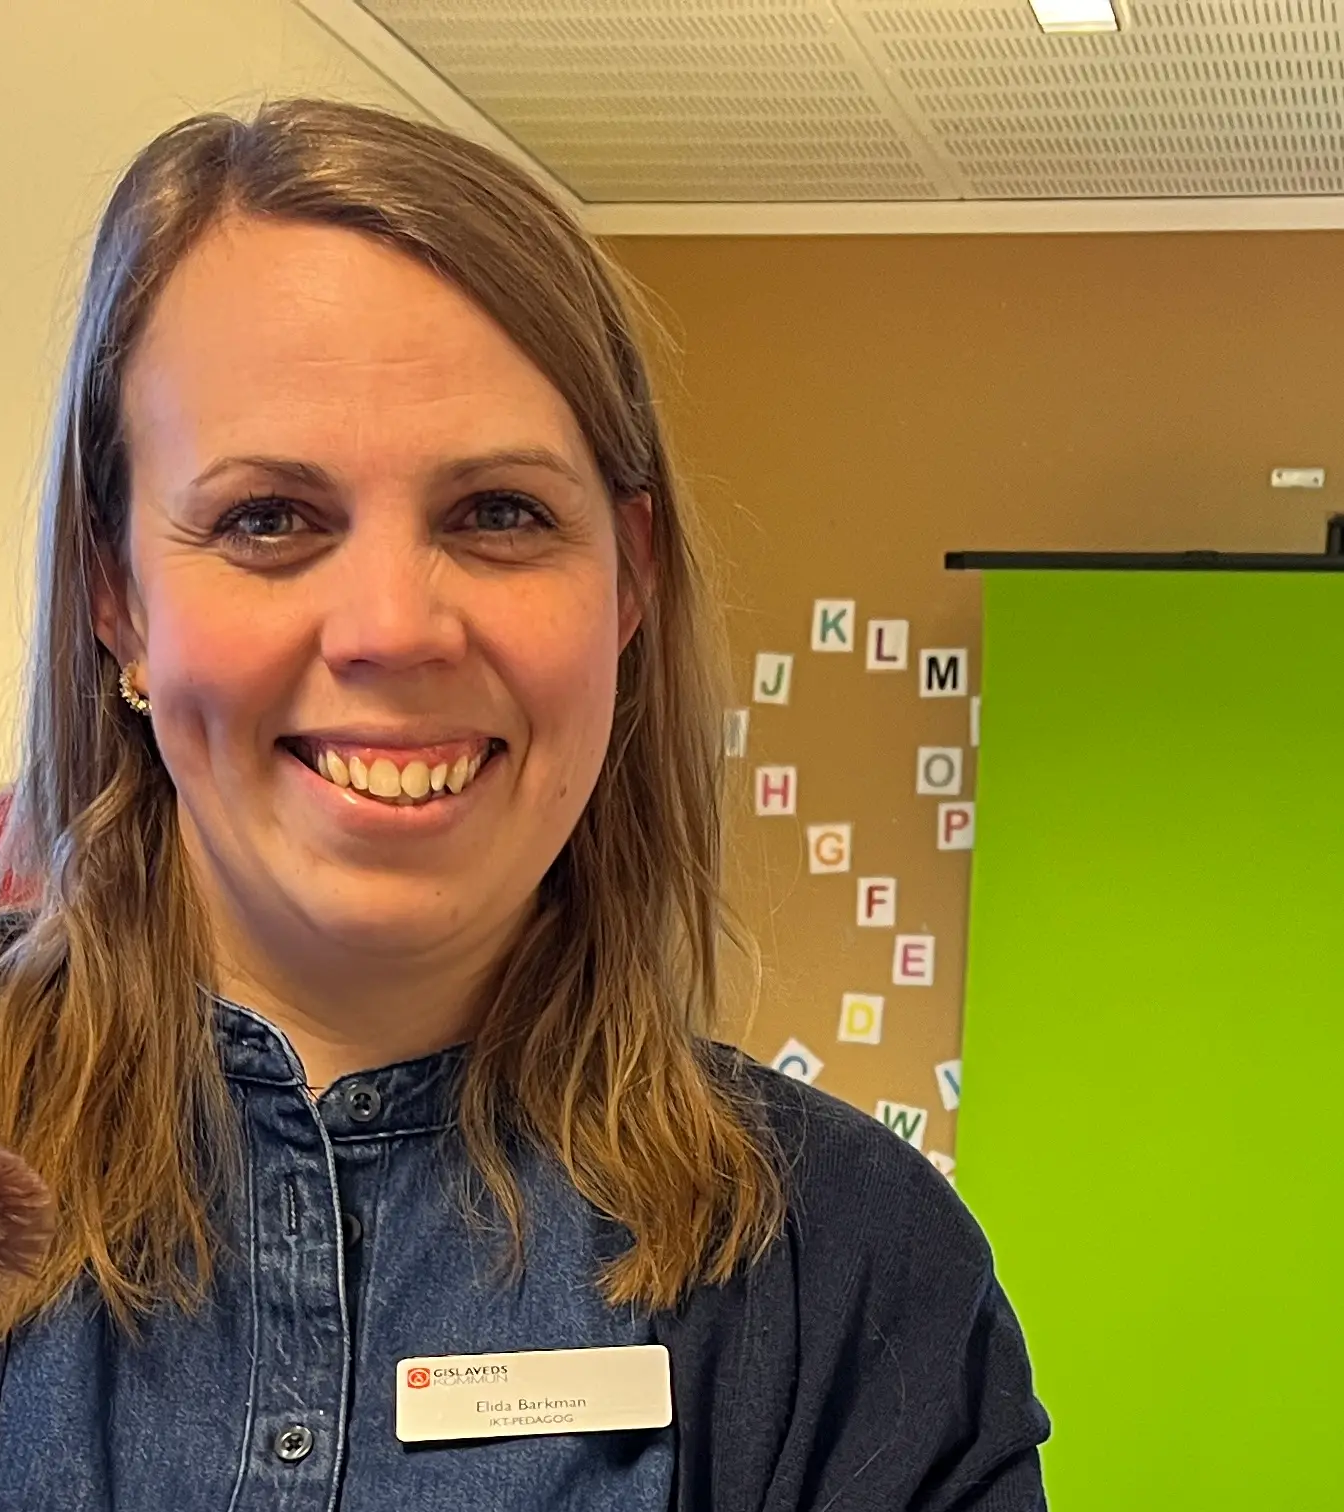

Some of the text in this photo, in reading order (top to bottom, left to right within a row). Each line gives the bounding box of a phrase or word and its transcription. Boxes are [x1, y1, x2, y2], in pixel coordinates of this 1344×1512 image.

[819, 608, 847, 643] K
[875, 627, 898, 662] L
[761, 662, 785, 696] J
[925, 656, 959, 691] M
[923, 753, 955, 788] O
[762, 774, 789, 808] H
[943, 809, 969, 843] P
[815, 832, 844, 866] G
[866, 885, 889, 919] F
[901, 943, 926, 977] E
[845, 1001, 874, 1036] D
[433, 1365, 508, 1378] GISLAVEDS
[433, 1374, 508, 1386] KOMMUN
[476, 1396, 587, 1413] Elida Barkman
